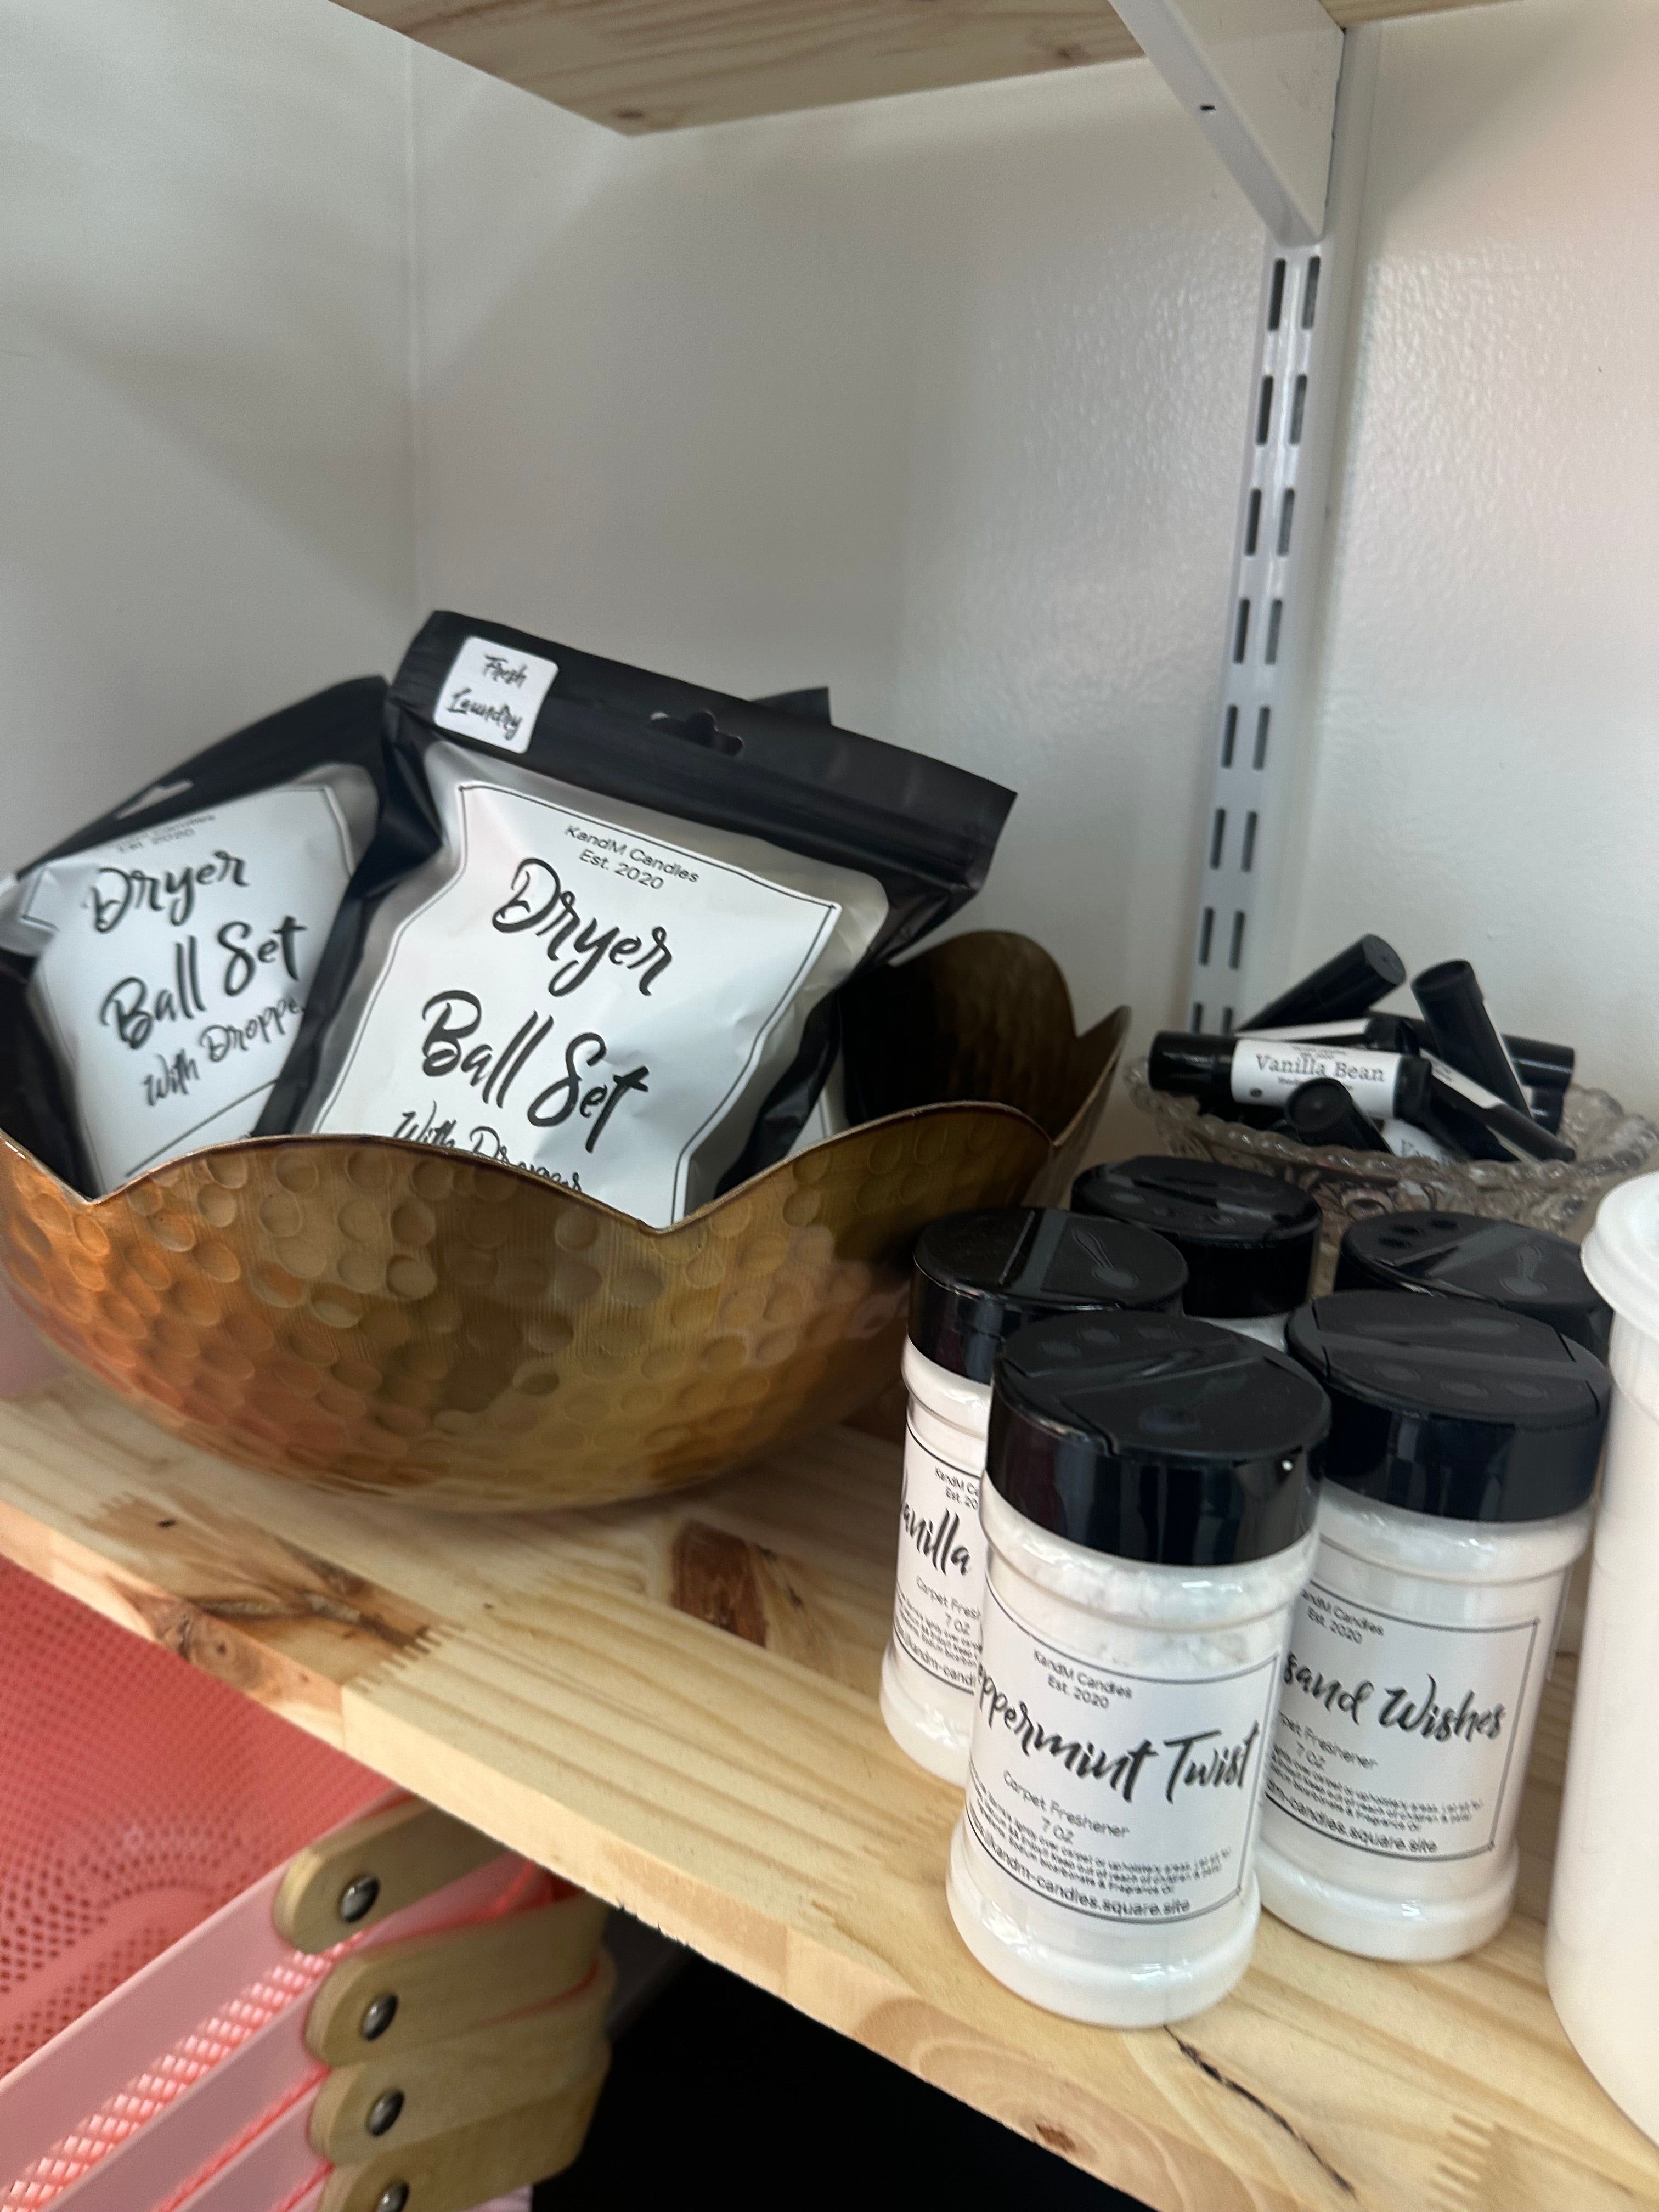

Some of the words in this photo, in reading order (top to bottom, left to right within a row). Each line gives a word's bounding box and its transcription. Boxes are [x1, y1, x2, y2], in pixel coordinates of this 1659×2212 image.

[92, 849, 249, 934] Dryer
[579, 848, 610, 871] Est.
[613, 862, 664, 890] 2020
[629, 848, 699, 883] Candles
[492, 858, 673, 996] Dryer
[101, 933, 206, 1050] Ball
[218, 914, 308, 997] Set
[143, 1048, 200, 1107] With
[422, 990, 555, 1110] Ball
[527, 1031, 650, 1154] Set
[1255, 1053, 1327, 1077] Vanilla
[1334, 1060, 1385, 1082] Bean
[1329, 1620, 1363, 1645] 2020
[1074, 1686, 1109, 1710] 2020
[1076, 1672, 1132, 1700] Candles
[1379, 1672, 1505, 1743] Wishes
[1163, 1720, 1259, 1804] Twist
[1003, 1769, 1046, 1812] Carpet
[1049, 1799, 1130, 1838] Freshener
